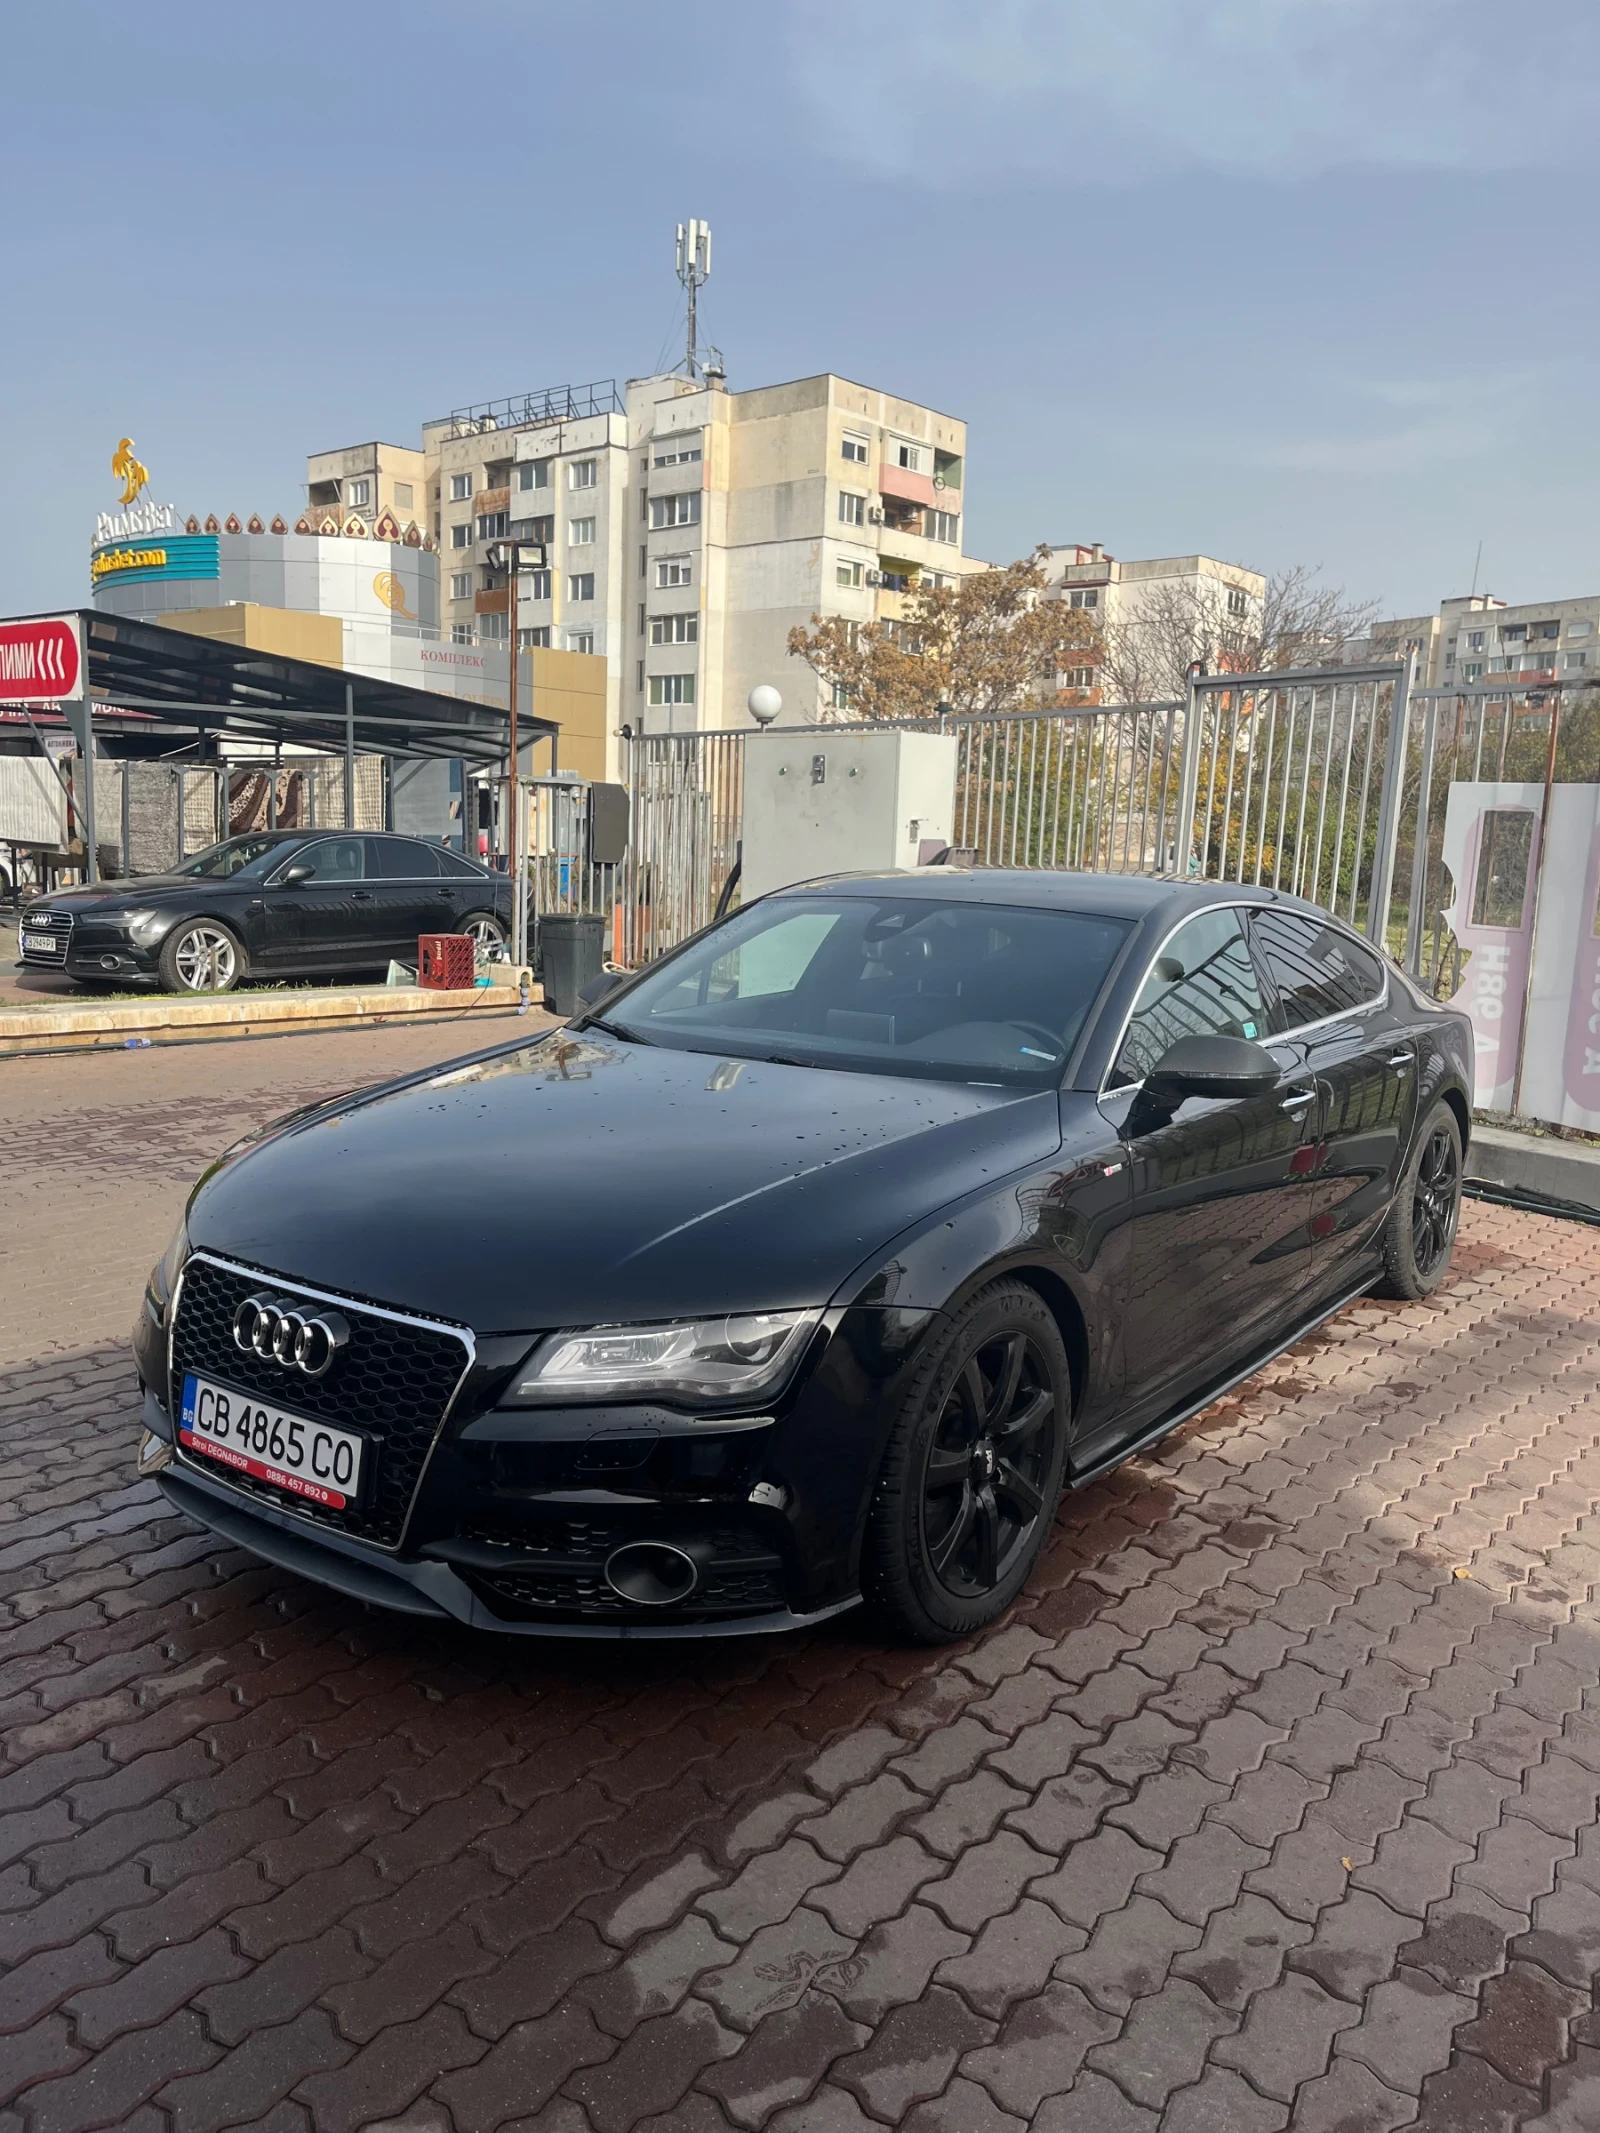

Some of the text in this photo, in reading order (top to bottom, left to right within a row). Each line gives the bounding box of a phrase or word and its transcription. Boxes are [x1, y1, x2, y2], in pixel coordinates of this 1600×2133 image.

[420, 649, 488, 668] КОМПЛЕКС
[182, 1407, 194, 1423] BG
[197, 1388, 354, 1486] CB 4865 CO
[265, 1468, 287, 1485] 0886
[287, 1478, 304, 1491] 457
[304, 1484, 321, 1499] 892
